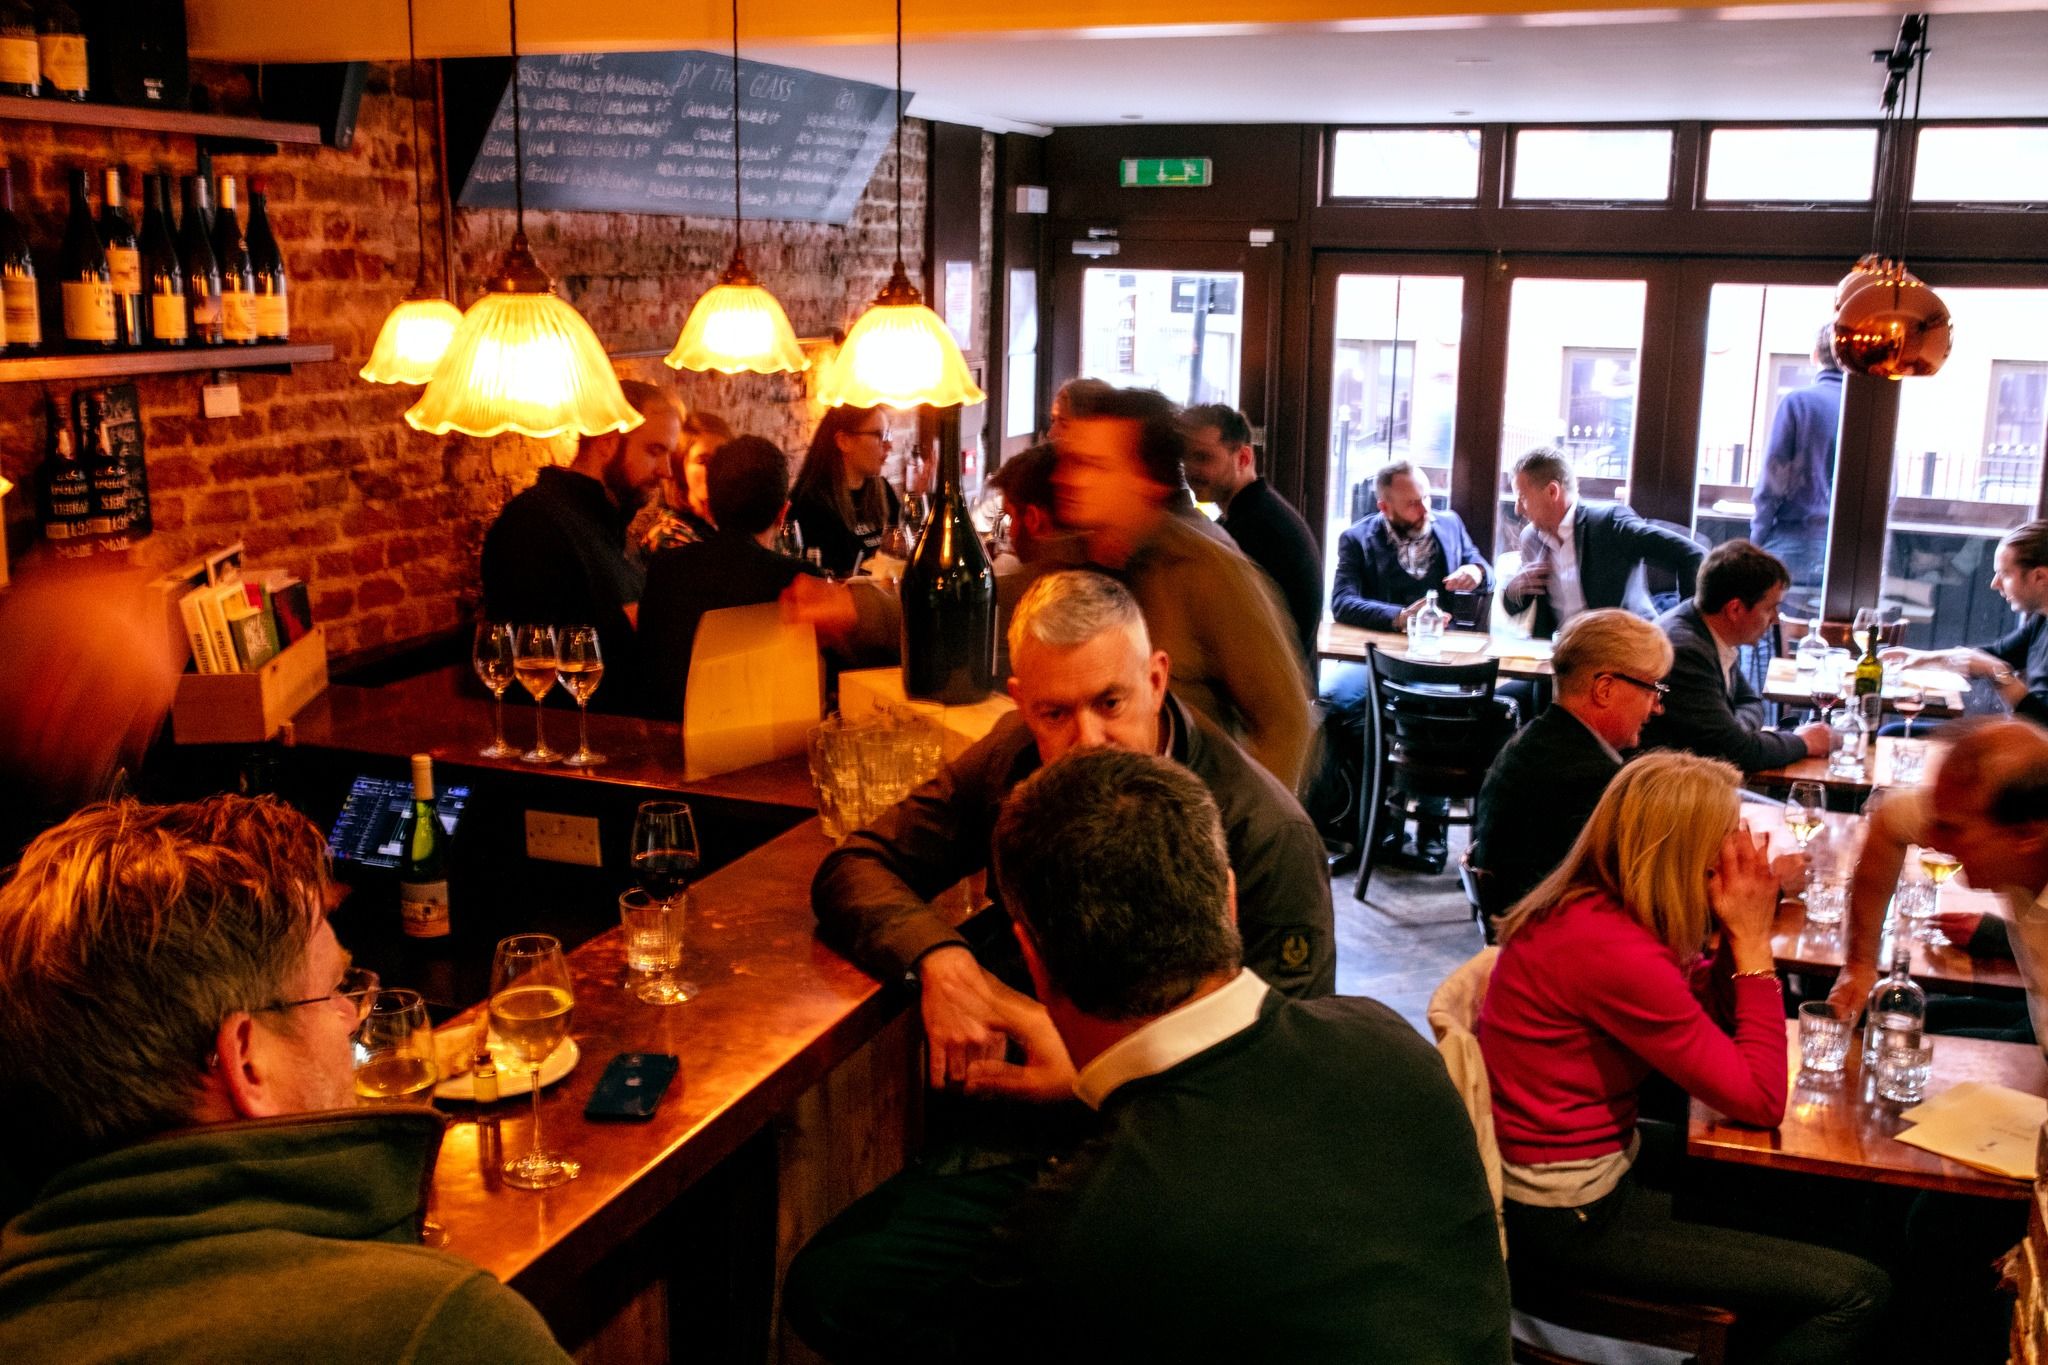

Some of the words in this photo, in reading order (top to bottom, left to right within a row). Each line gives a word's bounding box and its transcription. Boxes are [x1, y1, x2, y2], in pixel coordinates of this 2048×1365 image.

[673, 62, 708, 91] BY
[710, 67, 745, 94] THE
[749, 71, 796, 102] GLASS
